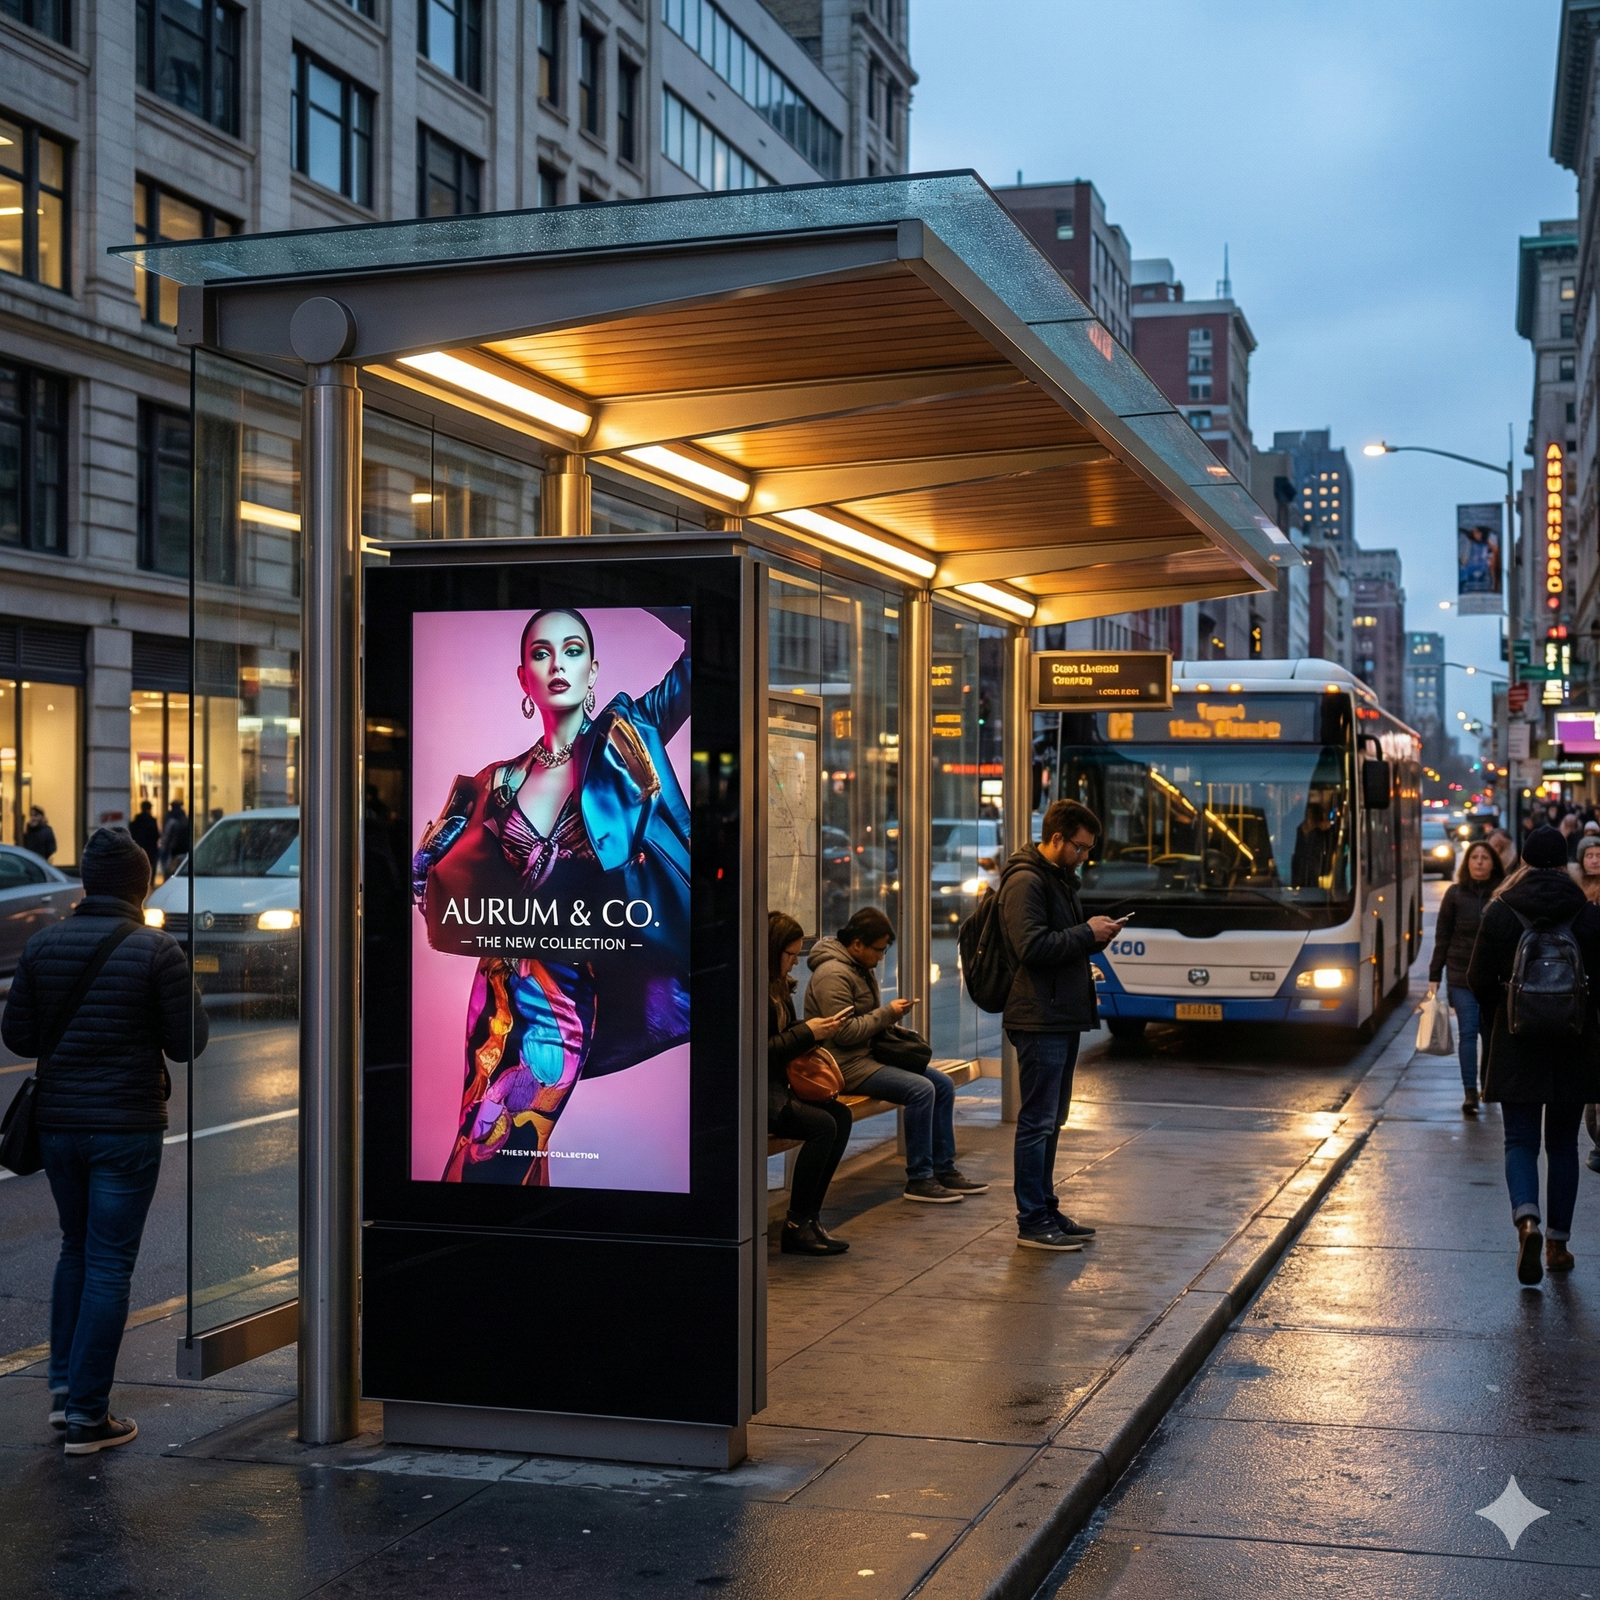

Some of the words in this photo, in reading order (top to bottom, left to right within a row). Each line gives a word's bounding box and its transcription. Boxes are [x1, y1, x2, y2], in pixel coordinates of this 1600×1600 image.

[441, 898, 559, 926] AURUM
[569, 899, 591, 926] &
[602, 899, 660, 928] CO.
[476, 936, 501, 948] THE
[505, 936, 536, 949] NEW
[540, 937, 626, 950] COLLECTION
[550, 1151, 599, 1160] COLLECTION
